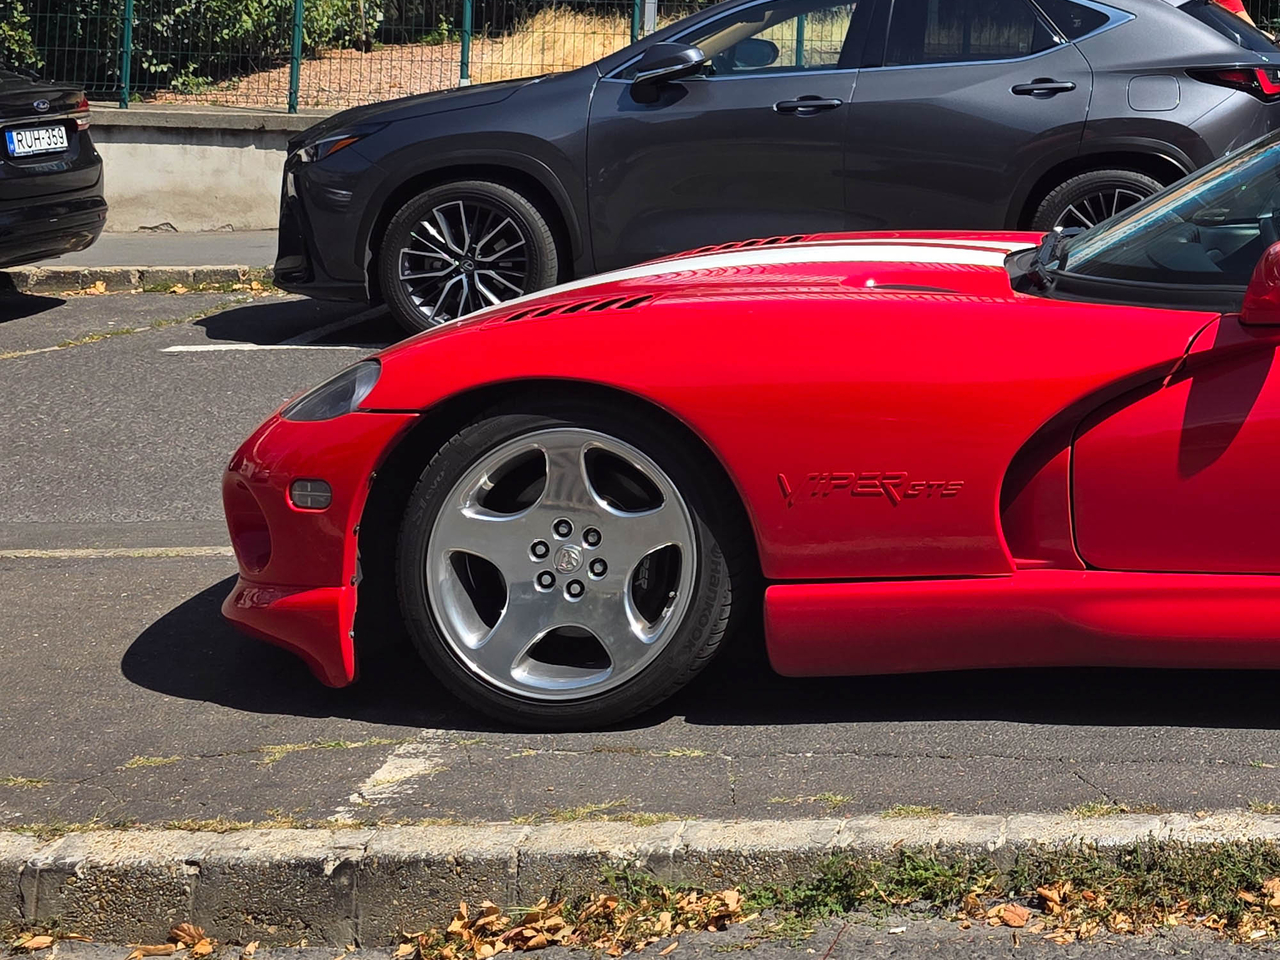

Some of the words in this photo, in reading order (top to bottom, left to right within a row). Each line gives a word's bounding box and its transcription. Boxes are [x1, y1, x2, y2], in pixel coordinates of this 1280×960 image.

[16, 128, 65, 149] RUH-359
[777, 471, 908, 509] VIPER
[634, 555, 651, 590] PER
